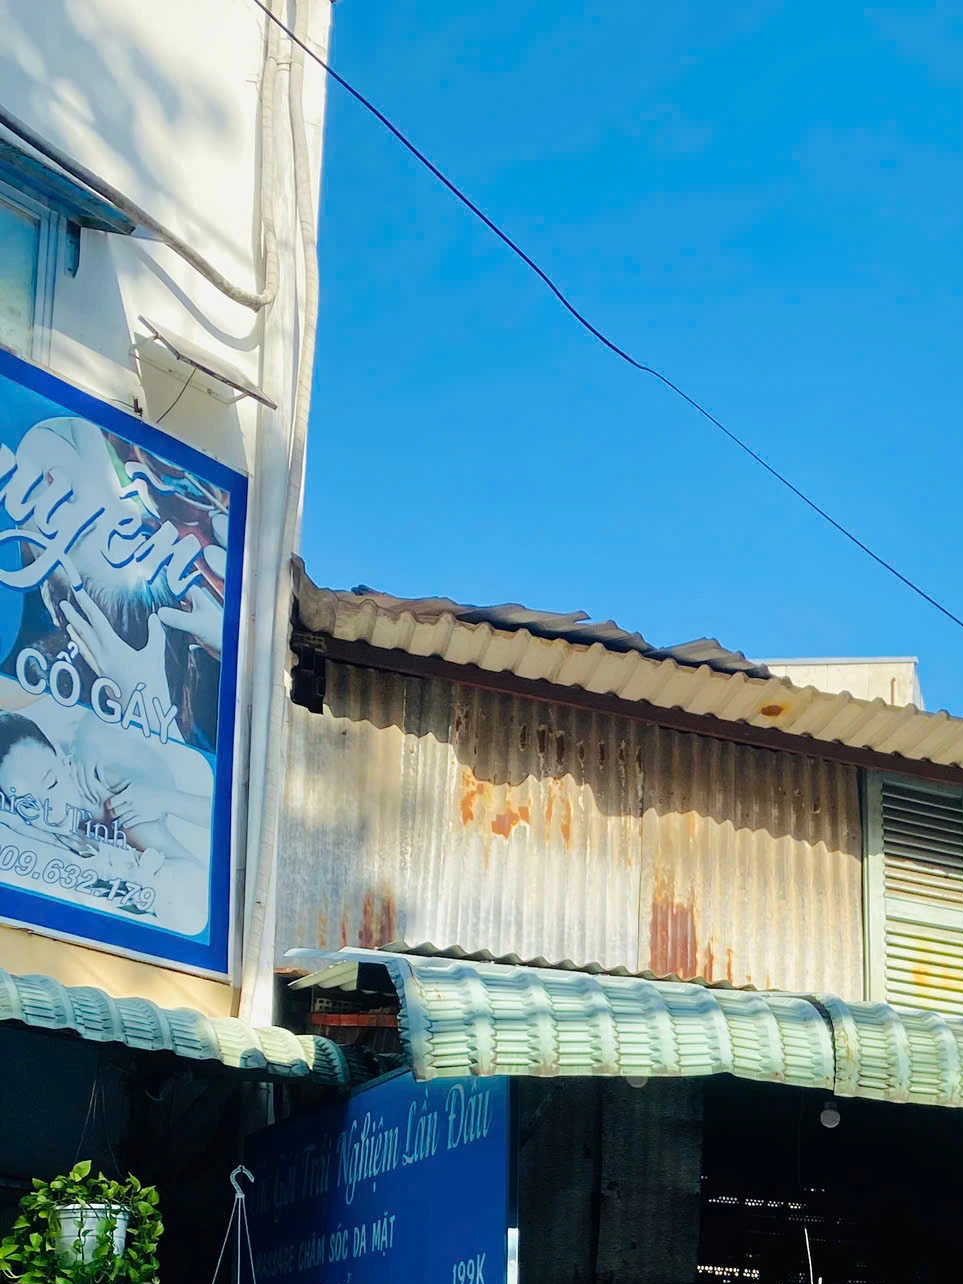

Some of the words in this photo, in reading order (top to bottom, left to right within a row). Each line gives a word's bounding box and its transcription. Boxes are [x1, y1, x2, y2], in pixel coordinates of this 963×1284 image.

[15, 640, 80, 708] CỔ
[91, 677, 178, 745] GÁY
[0, 845, 157, 911] 09.632.179
[337, 1112, 399, 1205] Nghiệm
[328, 1222, 349, 1262] SÓC
[353, 1224, 367, 1258] DA
[372, 1211, 396, 1257] MẶT
